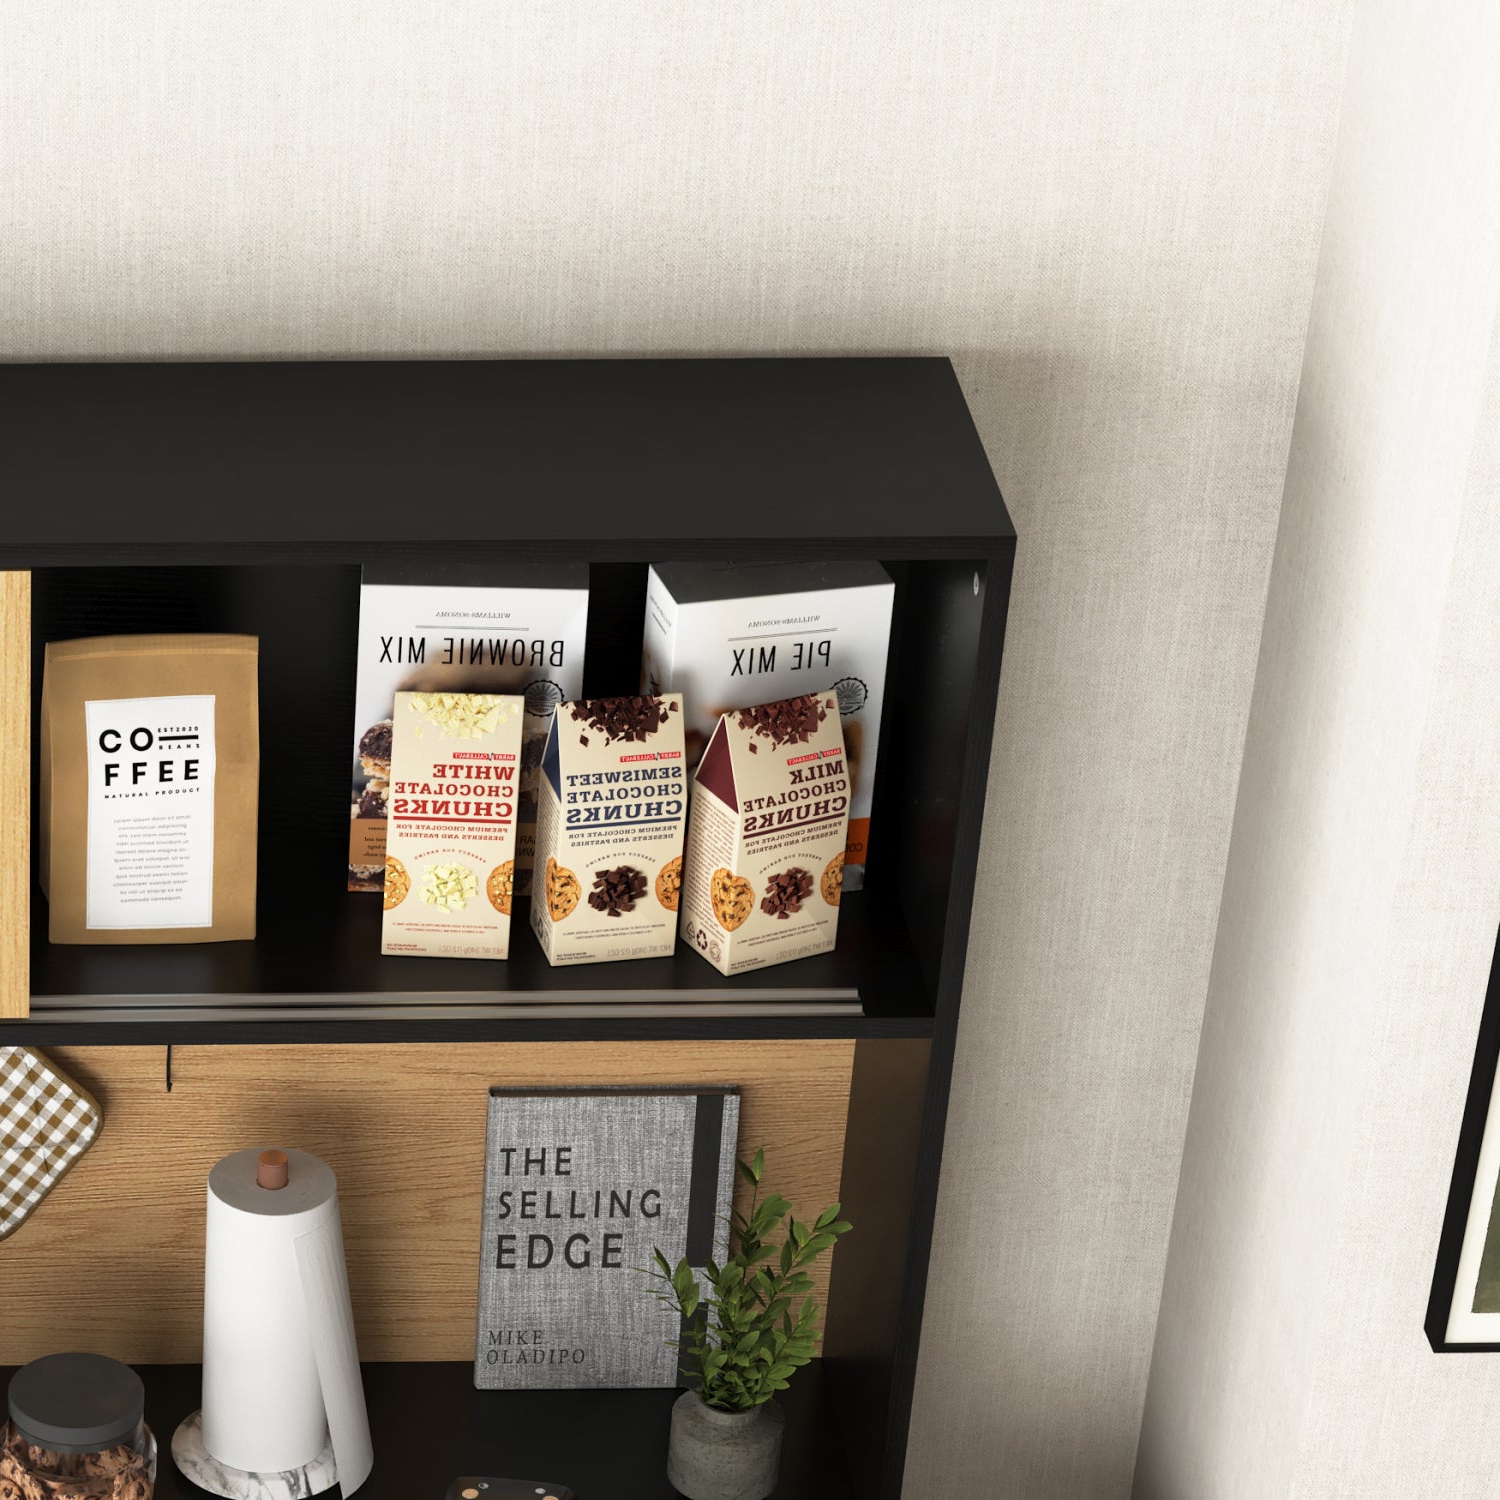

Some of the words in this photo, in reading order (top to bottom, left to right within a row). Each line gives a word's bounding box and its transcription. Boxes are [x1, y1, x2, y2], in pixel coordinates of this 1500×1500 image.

[105, 759, 199, 786] FFEE
[499, 1147, 572, 1176] THE
[498, 1189, 662, 1219] SELLING
[496, 1233, 623, 1269] EDGE
[488, 1330, 544, 1345] MIKE
[486, 1349, 586, 1365] OLADIPO
